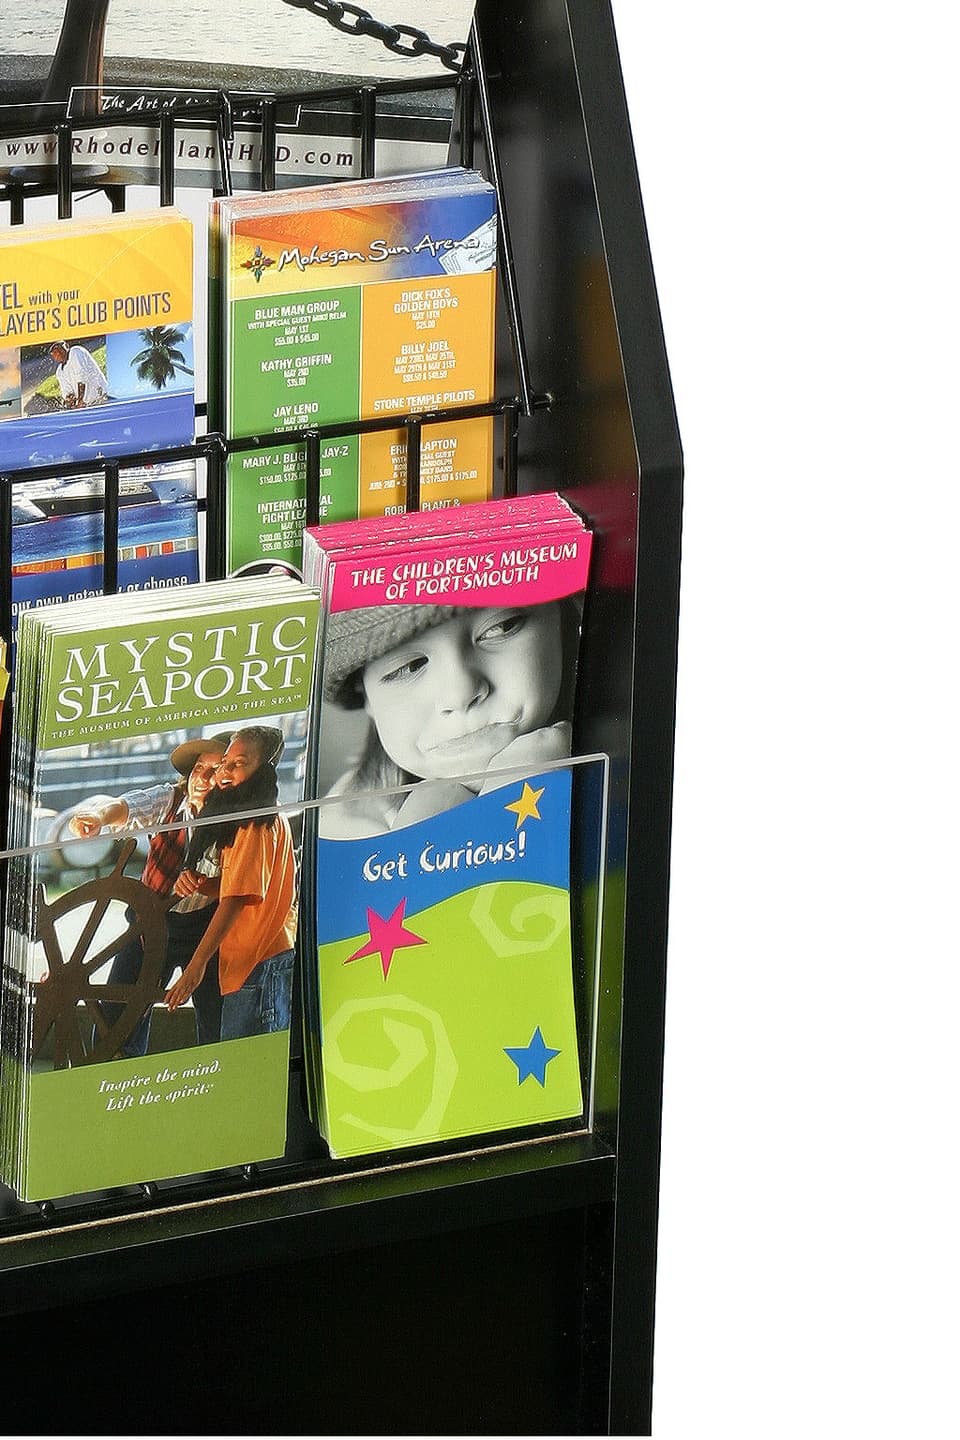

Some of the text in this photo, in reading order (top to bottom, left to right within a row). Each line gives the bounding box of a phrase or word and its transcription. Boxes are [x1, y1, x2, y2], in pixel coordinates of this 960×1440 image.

[100, 95, 159, 112] The Art
[277, 234, 480, 272] Mohegan Sun Arena
[28, 289, 54, 305] with
[57, 288, 81, 306] your
[394, 297, 458, 314] GOLDEN BOYS
[67, 302, 108, 328] CLUB
[113, 292, 172, 321] POINTS
[255, 300, 340, 320] BLUE MAN GROUP
[401, 340, 449, 355] BILLY JOEL
[261, 354, 332, 372] KATHY GRIFFIN
[374, 398, 404, 411] STONE
[406, 393, 442, 407] TEMPLE
[443, 390, 476, 402] PILOTS
[273, 406, 292, 418] JAY
[243, 455, 271, 469] MARY
[262, 511, 289, 524] FIGHT
[351, 541, 579, 589] THE CHILDREN'S MUSEUM
[385, 565, 540, 601] OF PORTSMOUTH
[59, 615, 308, 685] MYSTIC
[51, 729, 75, 740] THE
[79, 720, 131, 735] MUSEUM
[155, 708, 209, 723] AMERICA
[213, 703, 238, 714] AND
[243, 698, 266, 710] THE
[362, 830, 527, 881] Get Curious!
[98, 1068, 177, 1095] Inspire the
[106, 1097, 133, 1112] Lift
[139, 1090, 161, 1106] the
